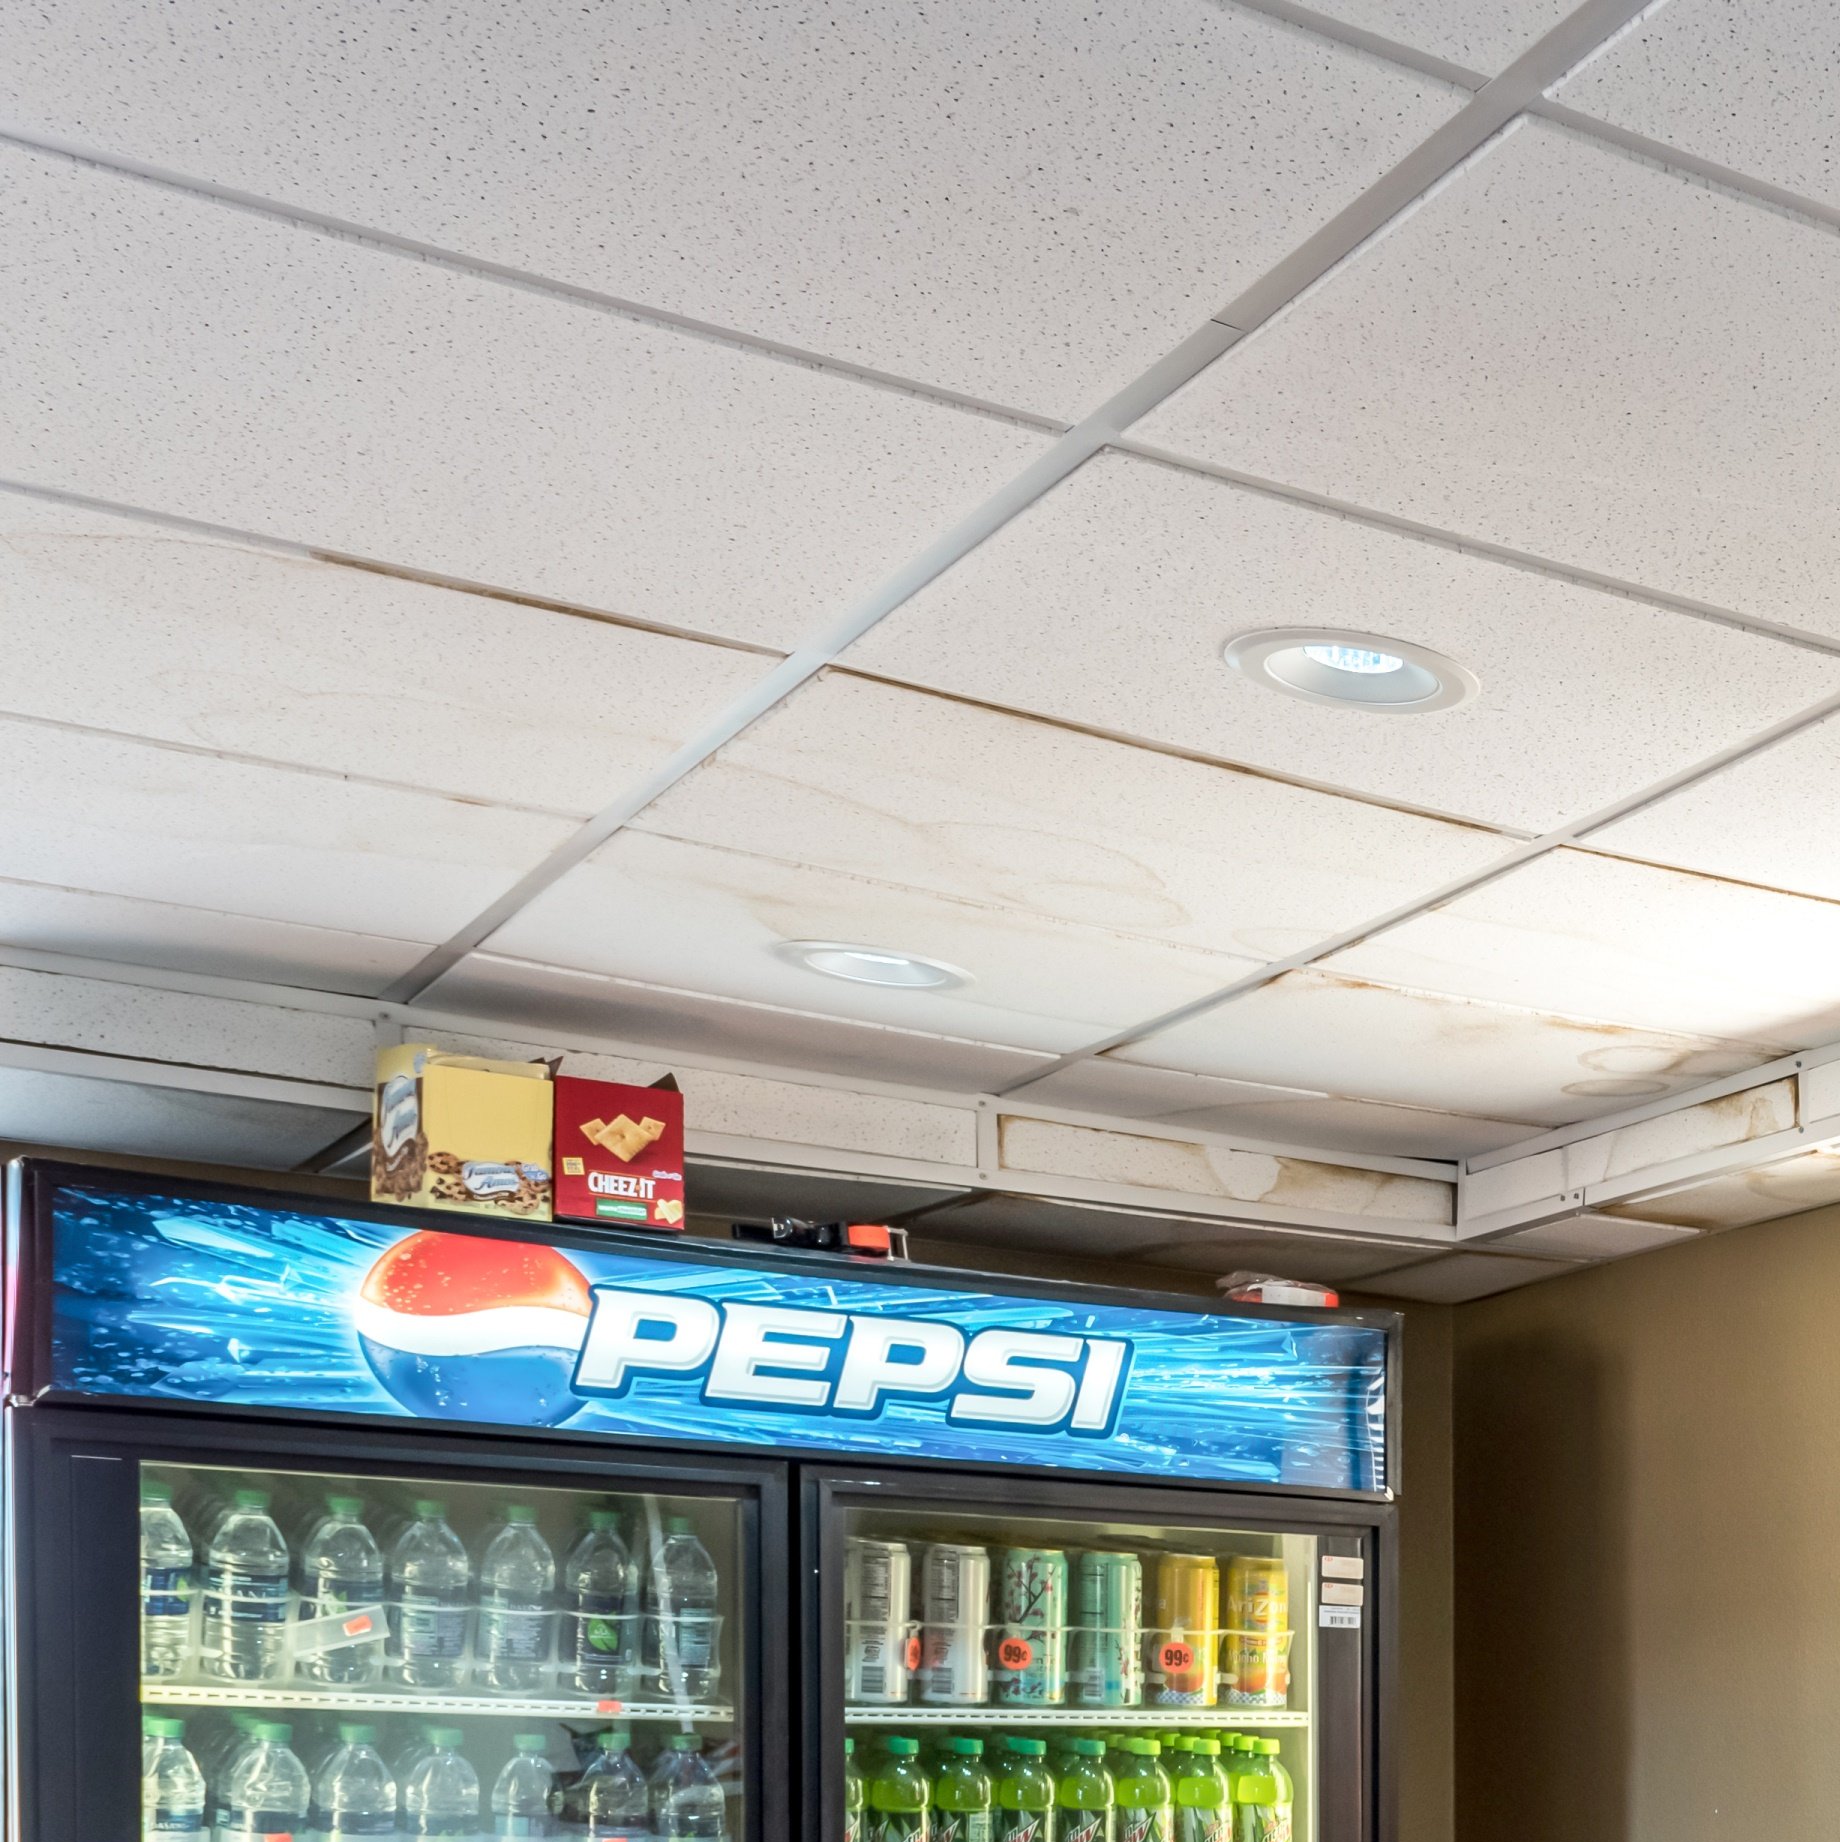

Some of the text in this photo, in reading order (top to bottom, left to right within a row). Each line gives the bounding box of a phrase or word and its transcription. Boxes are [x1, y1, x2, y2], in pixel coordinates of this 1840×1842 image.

[575, 1290, 1129, 1432] PEPSI
[1003, 1644, 1028, 1663] 99¢
[1164, 1650, 1189, 1666] 99¢
